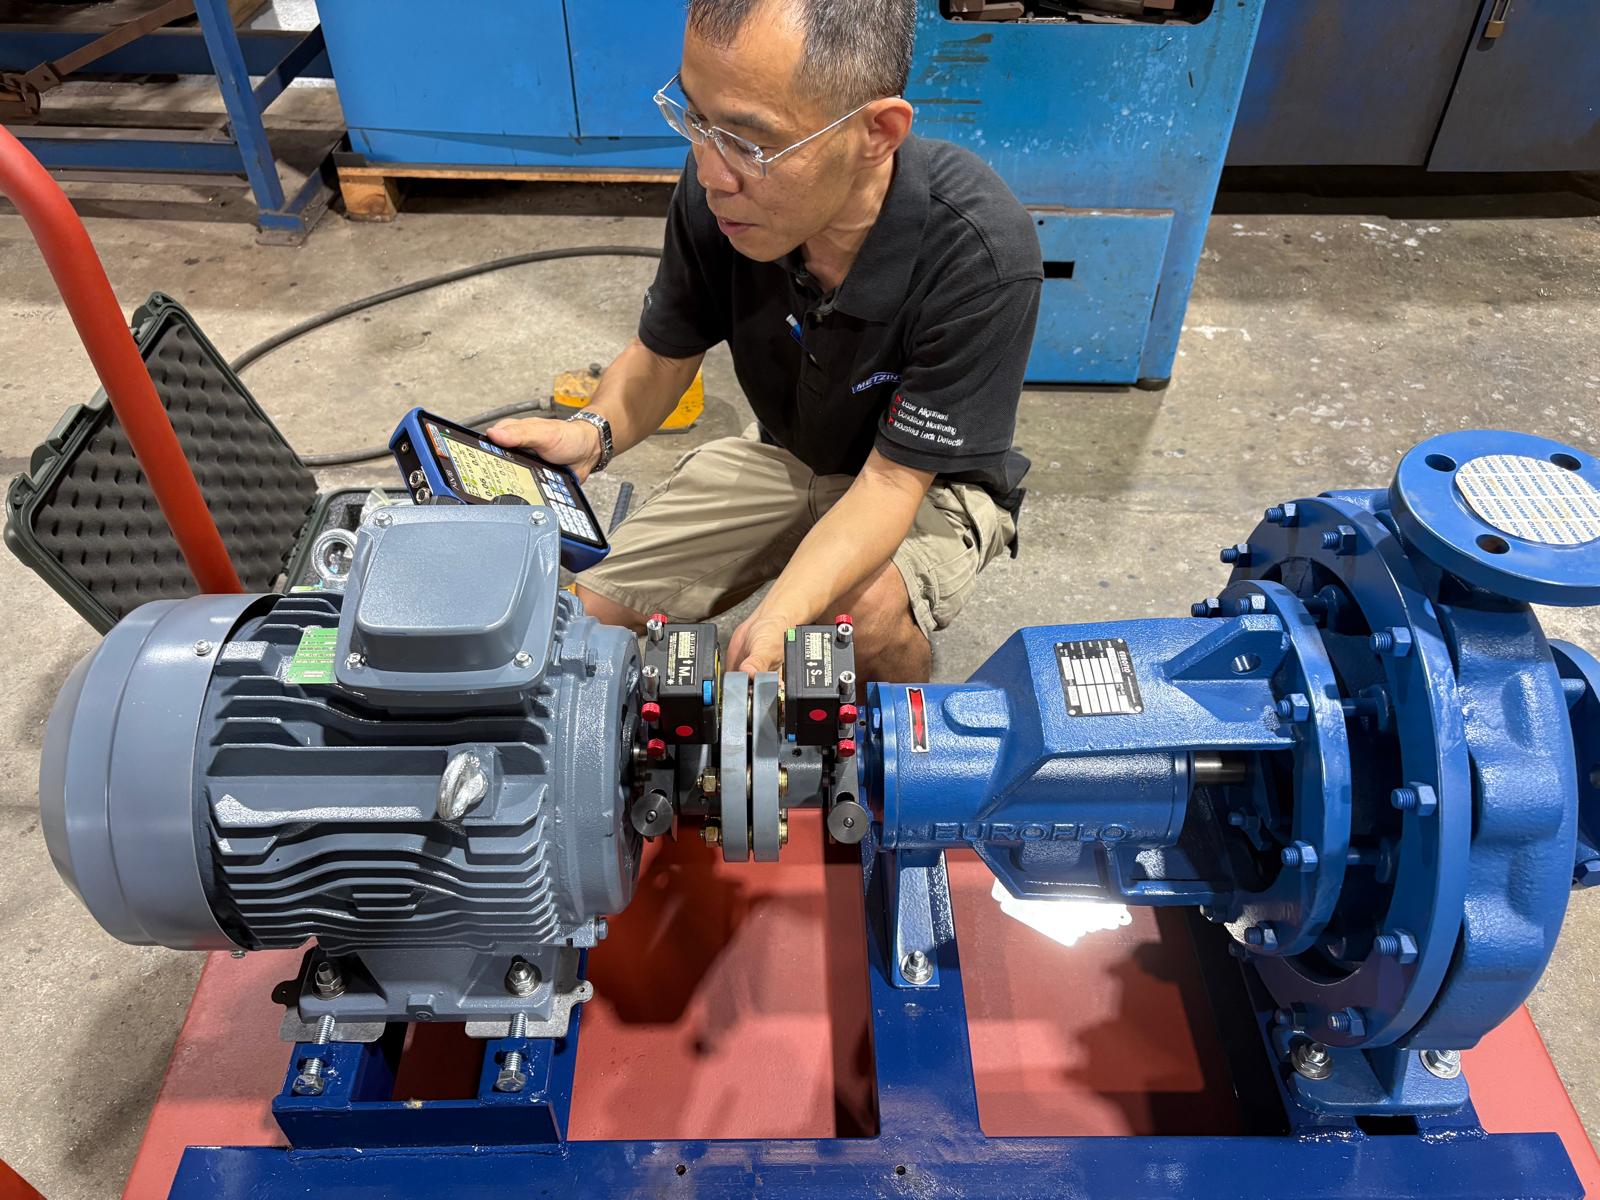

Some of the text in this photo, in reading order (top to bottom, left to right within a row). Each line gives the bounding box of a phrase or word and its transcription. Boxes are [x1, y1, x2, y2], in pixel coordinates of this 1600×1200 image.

[918, 407, 949, 421] Alignment
[897, 409, 957, 436] Condition Monitoring
[678, 666, 691, 676] M
[810, 668, 823, 676] S
[933, 822, 1127, 841] EUROFLO
